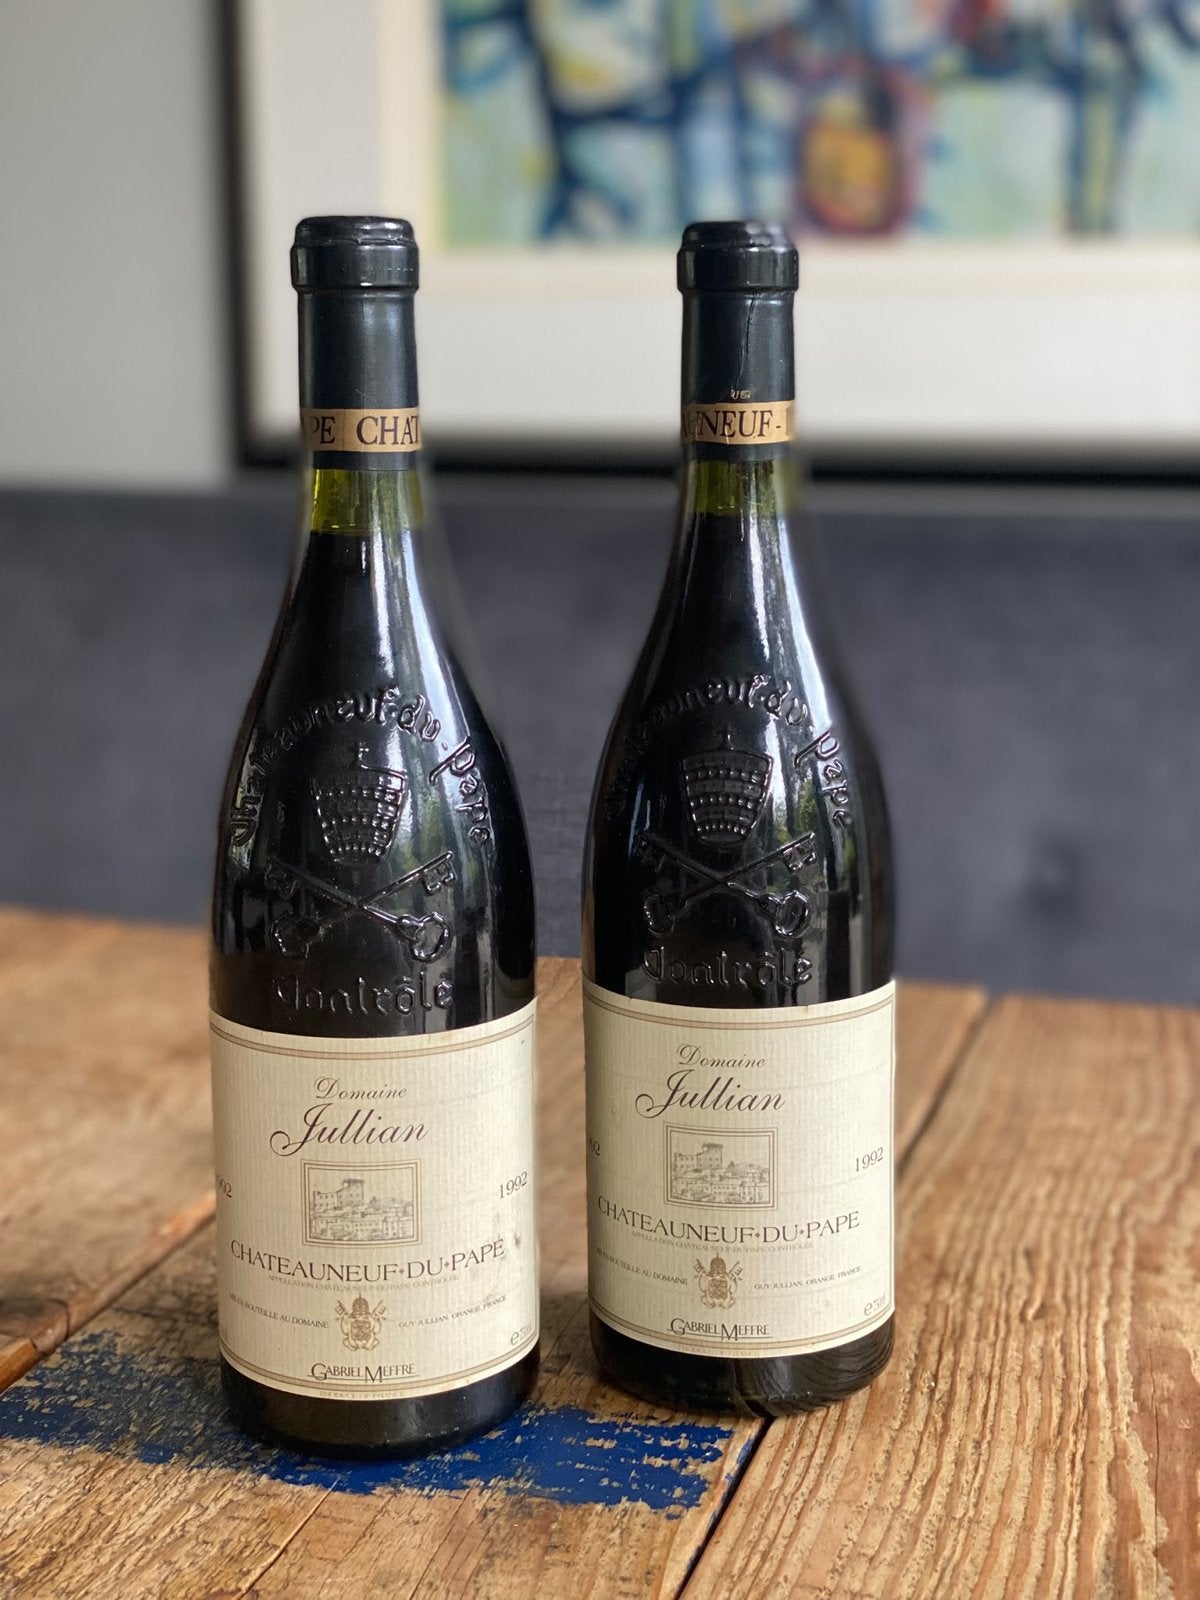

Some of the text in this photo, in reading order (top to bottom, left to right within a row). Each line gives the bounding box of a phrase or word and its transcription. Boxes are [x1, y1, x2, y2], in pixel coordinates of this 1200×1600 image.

[677, 1043, 767, 1069] Domaine
[314, 1076, 407, 1100] Domaine
[635, 1068, 785, 1119] Jullian
[269, 1102, 428, 1157] Jullian
[856, 1146, 884, 1172] 1992
[500, 1171, 528, 1199] 1992
[653, 1271, 688, 1286] DOMAINE
[292, 1316, 329, 1329] DOMAINE
